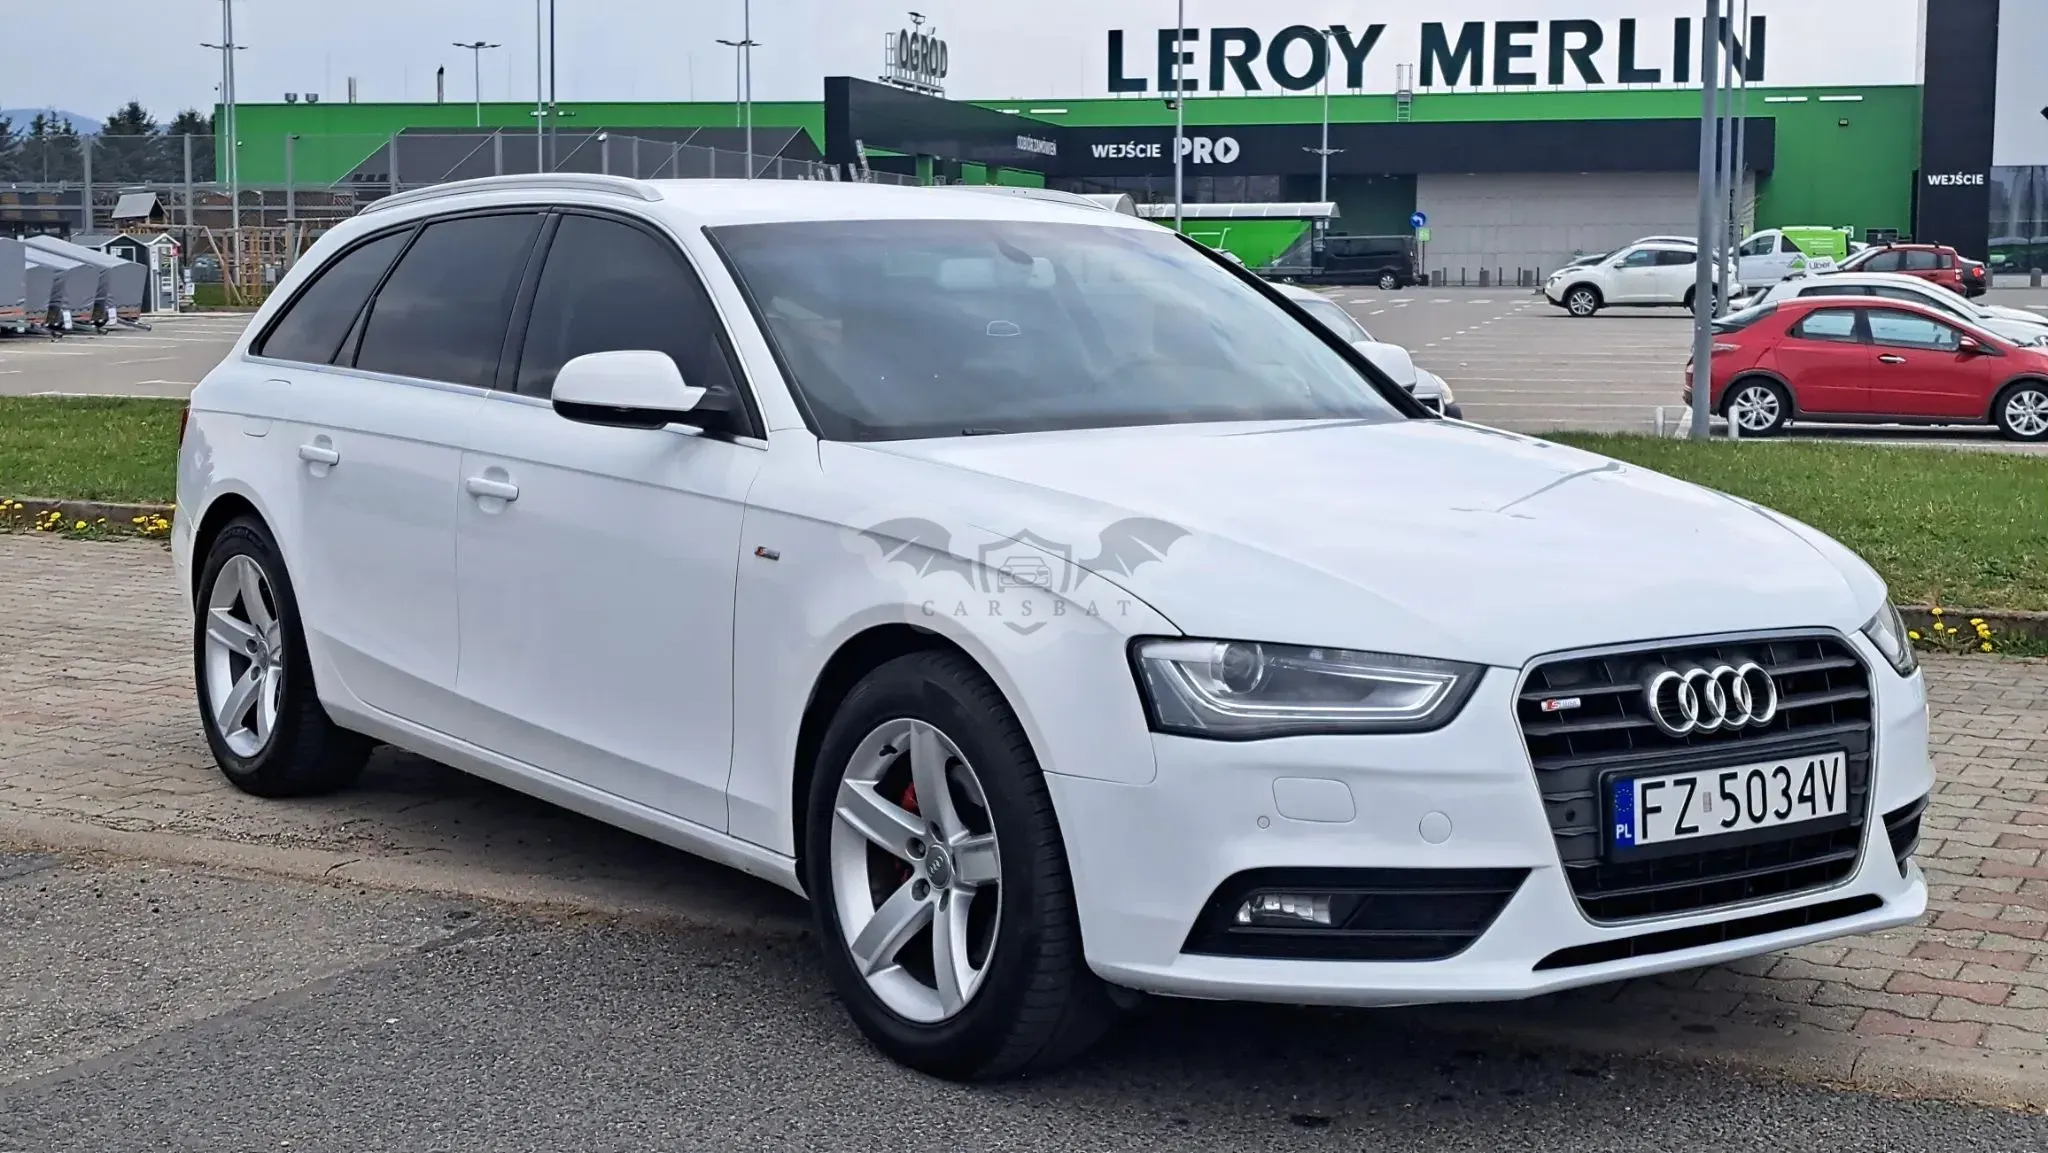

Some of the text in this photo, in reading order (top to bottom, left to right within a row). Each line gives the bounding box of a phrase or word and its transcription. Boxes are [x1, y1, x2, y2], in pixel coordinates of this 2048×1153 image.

[898, 27, 948, 78] OGRÓD
[1108, 16, 1766, 92] LEROY MERLIN
[1092, 136, 1240, 164] WEJŚCIE PRO
[1927, 171, 1984, 185] WEJŚCIE
[1809, 260, 1831, 270] Uber
[1640, 757, 1839, 840] FZ 5034V
[1615, 824, 1632, 840] PL
